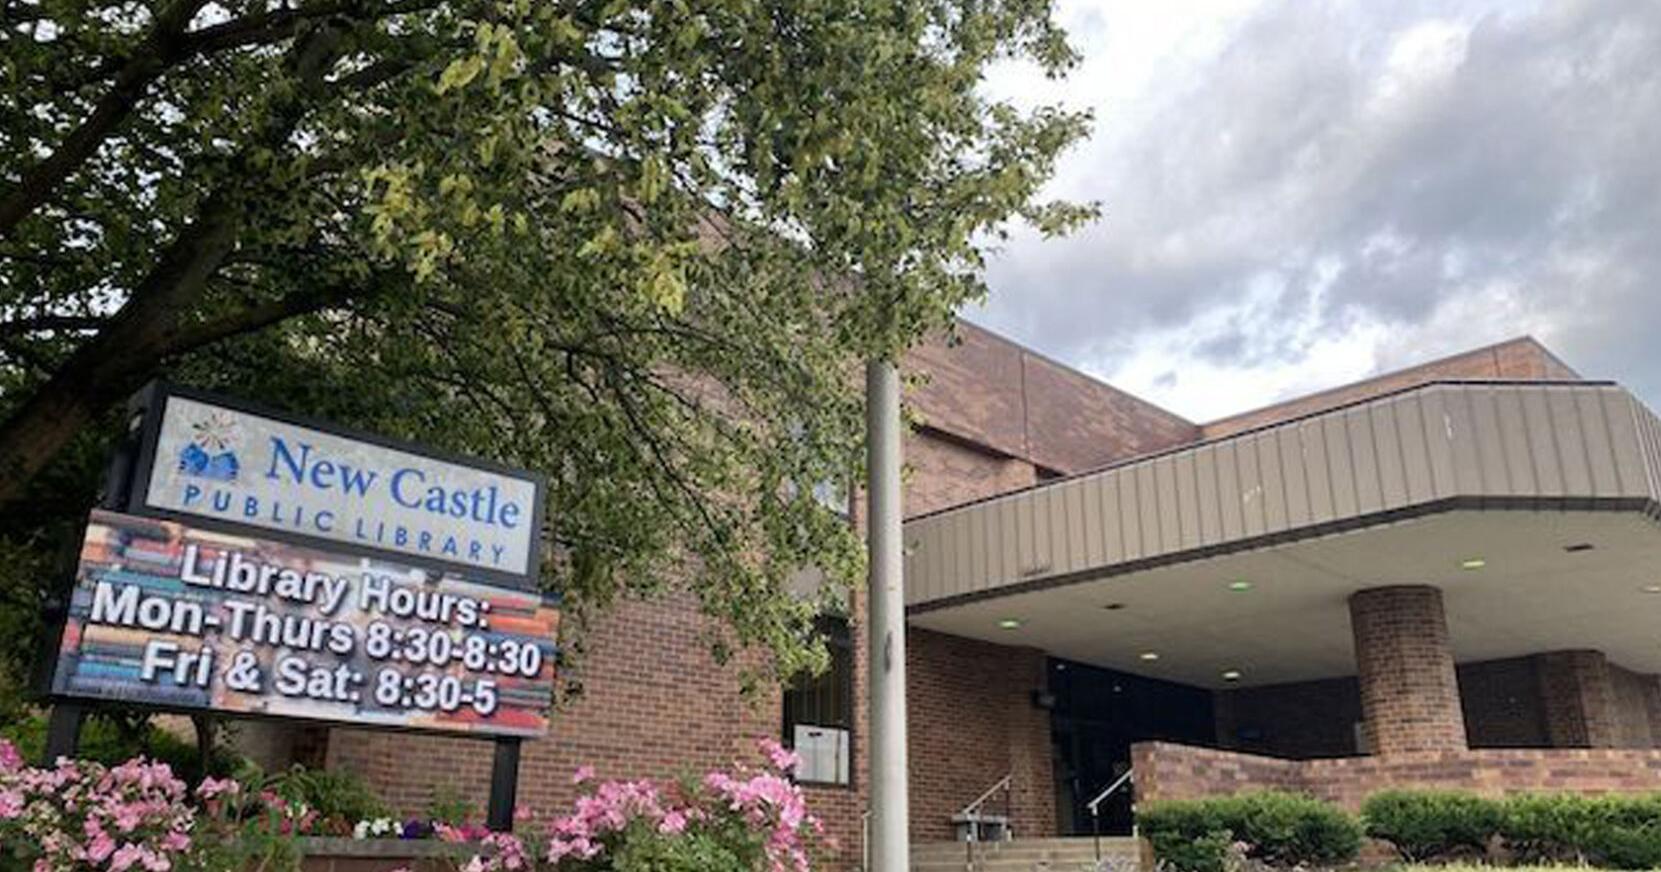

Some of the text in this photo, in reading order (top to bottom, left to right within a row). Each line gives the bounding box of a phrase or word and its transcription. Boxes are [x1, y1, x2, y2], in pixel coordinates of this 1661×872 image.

[265, 437, 520, 529] New Castle
[183, 485, 506, 565] PUBLIC LIBRARY
[180, 544, 491, 627] Library Hours:
[91, 582, 541, 677] Mon-Thurs 8:30-8:30
[141, 641, 211, 686] Fri
[226, 654, 261, 691] &
[277, 657, 363, 701] Sat:
[376, 670, 496, 714] 8:30-5
